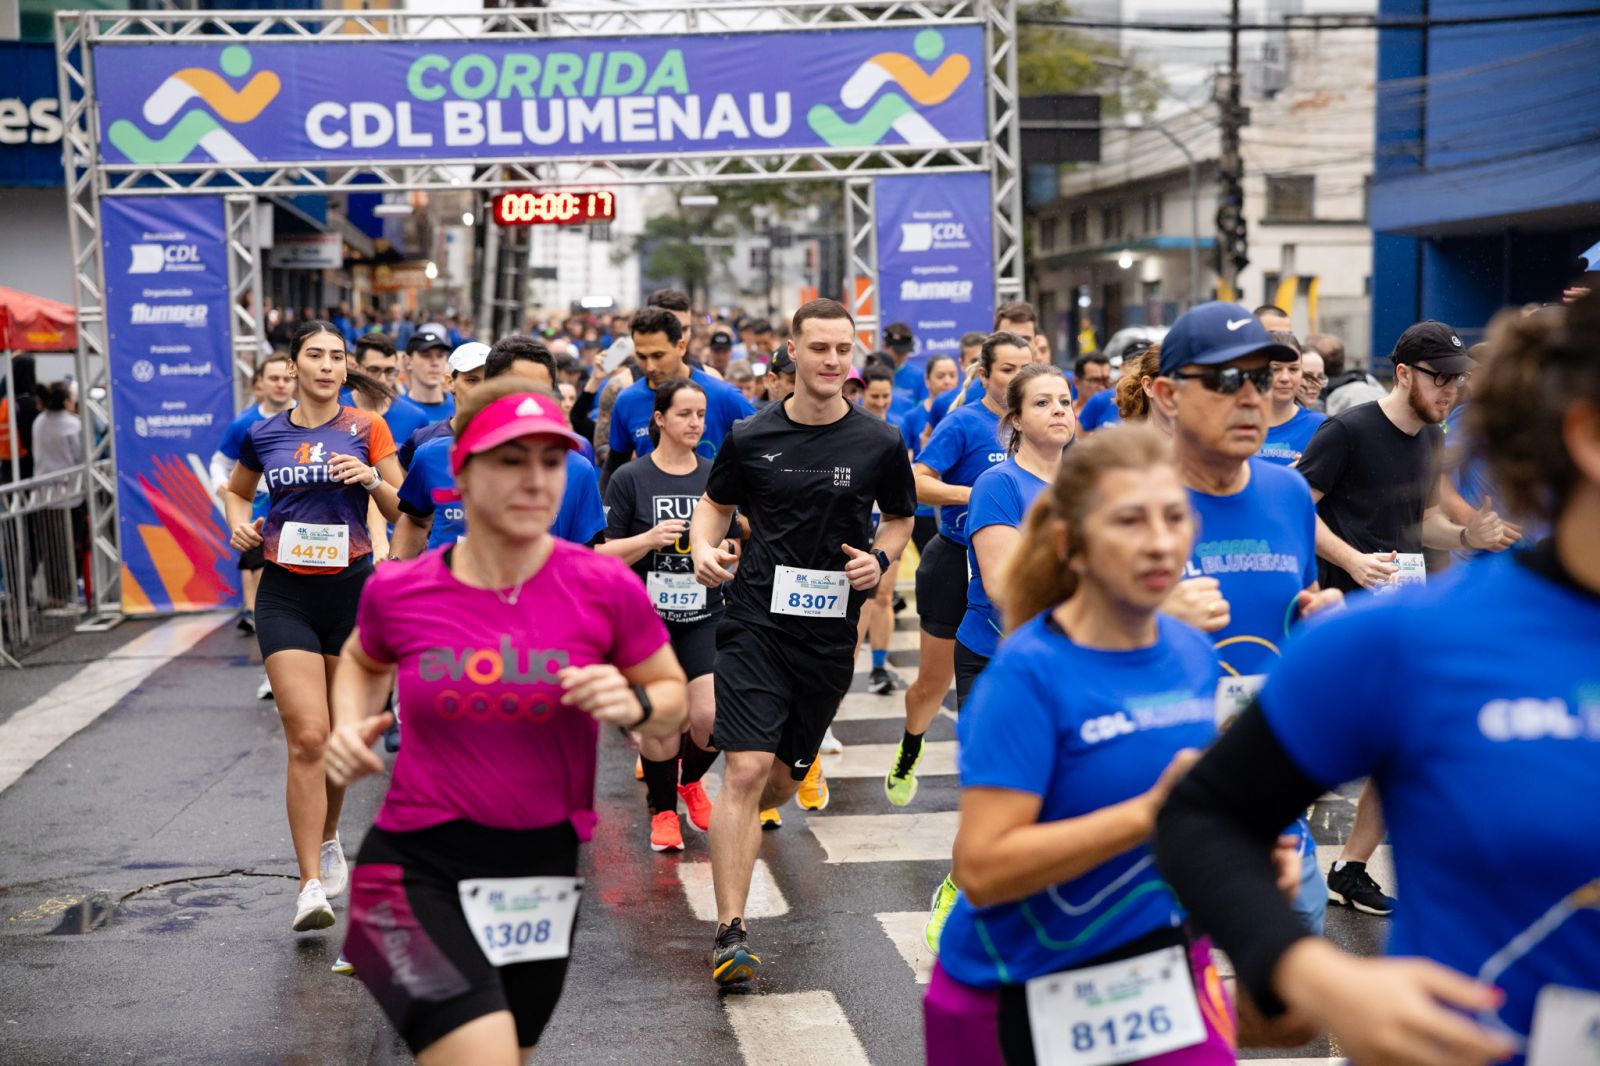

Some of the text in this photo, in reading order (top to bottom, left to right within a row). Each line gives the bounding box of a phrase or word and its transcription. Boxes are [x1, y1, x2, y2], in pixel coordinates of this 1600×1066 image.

[406, 49, 690, 101] CORRIDA
[304, 91, 792, 150] CDL BLUMENAU
[501, 191, 613, 222] 00:00:17
[932, 222, 966, 240] CDL
[164, 244, 201, 263] CDL
[444, 508, 465, 520] CD
[291, 545, 338, 560] 4479
[659, 592, 698, 605] 8157
[788, 592, 838, 610] 8307
[1080, 711, 1136, 744] CDL
[1072, 1004, 1173, 1052] 8126
